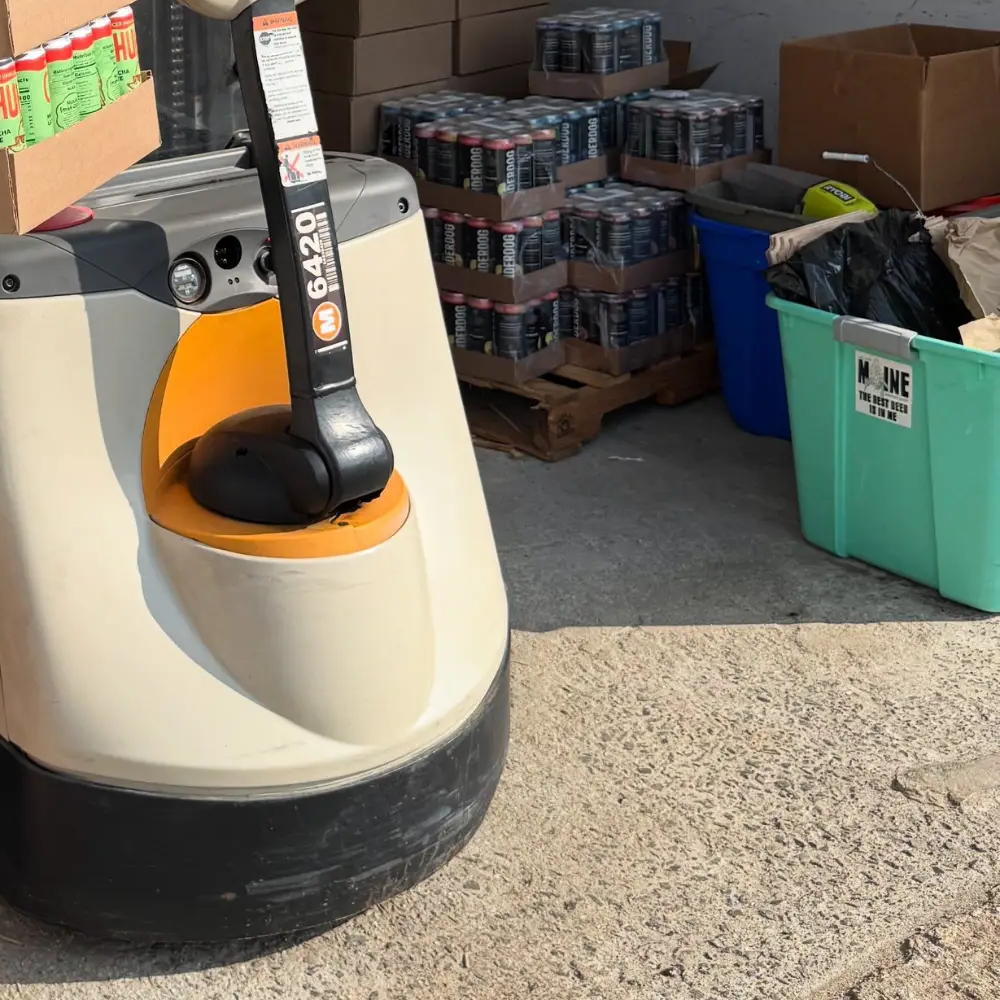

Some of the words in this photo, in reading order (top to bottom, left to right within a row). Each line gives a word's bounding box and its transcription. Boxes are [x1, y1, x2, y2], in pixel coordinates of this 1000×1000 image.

[823, 185, 853, 200] RYOBI
[295, 211, 328, 300] 6420
[318, 308, 337, 334] M
[858, 359, 910, 398] MINE
[859, 390, 872, 403] THE
[873, 395, 889, 408] BEST
[891, 401, 908, 414] BEER
[878, 407, 885, 418] IN
[887, 410, 897, 422] ME
